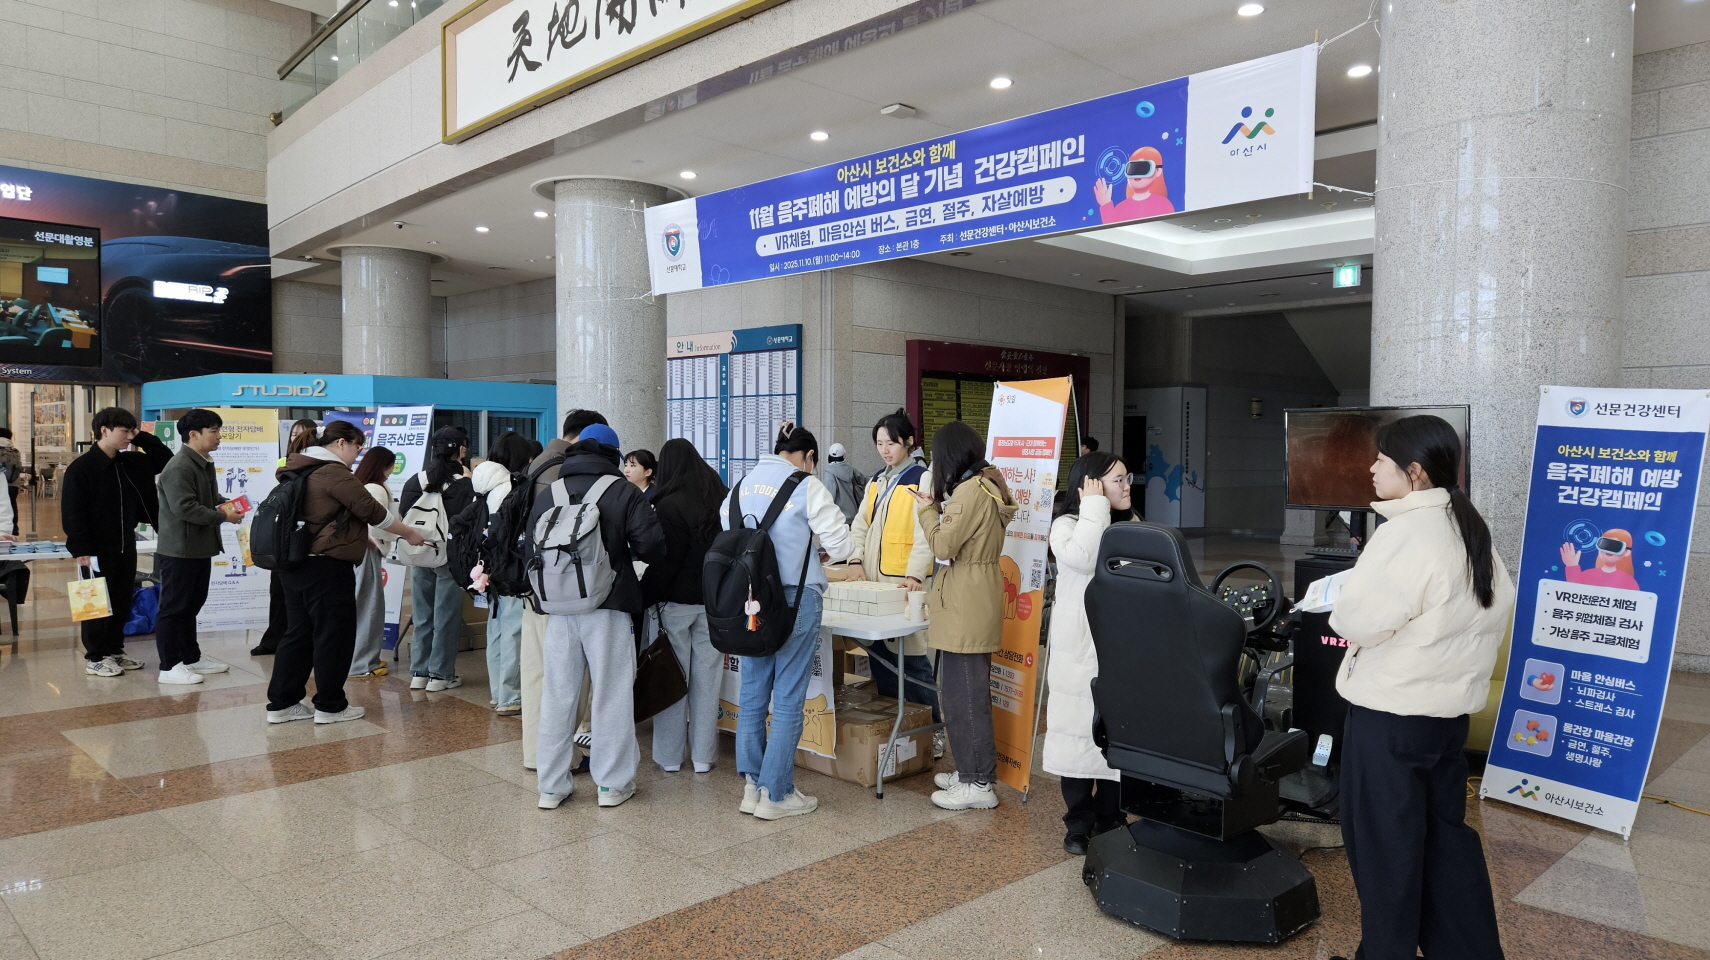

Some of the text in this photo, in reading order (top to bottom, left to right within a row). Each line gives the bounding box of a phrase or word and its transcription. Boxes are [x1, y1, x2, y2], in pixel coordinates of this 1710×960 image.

[1230, 143, 1267, 157] 아산시
[837, 140, 956, 184] 아산시 보건소와 함께
[749, 135, 1085, 230] 11월 음주폐해 예방의 달 기념 건강캠페인
[819, 219, 866, 243] 마음안심
[870, 214, 900, 234] 버스,
[905, 207, 936, 228] 금연,
[942, 199, 975, 221] 절주,
[981, 185, 1045, 214] 자살예방
[34, 231, 94, 247] 선문대촬영분
[1, 366, 32, 376] System
[1594, 402, 1681, 419] 선문건강센터
[377, 432, 425, 446] 음주신호등
[1557, 444, 1678, 463] 아산시 보건소와 함께
[1024, 468, 1036, 483] 사
[1546, 462, 1682, 489] 음주폐해 예방
[1014, 488, 1032, 505] 예방
[1557, 485, 1663, 511] 건강캠페인
[1555, 591, 1637, 611] VR안전운전 체험
[1552, 608, 1643, 632] 음주 위험체질 검사
[1592, 633, 1640, 650] 고글체험
[1571, 670, 1636, 691] 마음 안심버스
[1576, 687, 1616, 702] 뇌파검사
[1575, 699, 1636, 719] 스트레스 검사
[1562, 722, 1635, 748] 몸건강 마음건강
[996, 752, 1022, 771] 건강복지센터
[1565, 751, 1603, 768] 생명사랑
[1544, 792, 1604, 816] 아산시보건소
